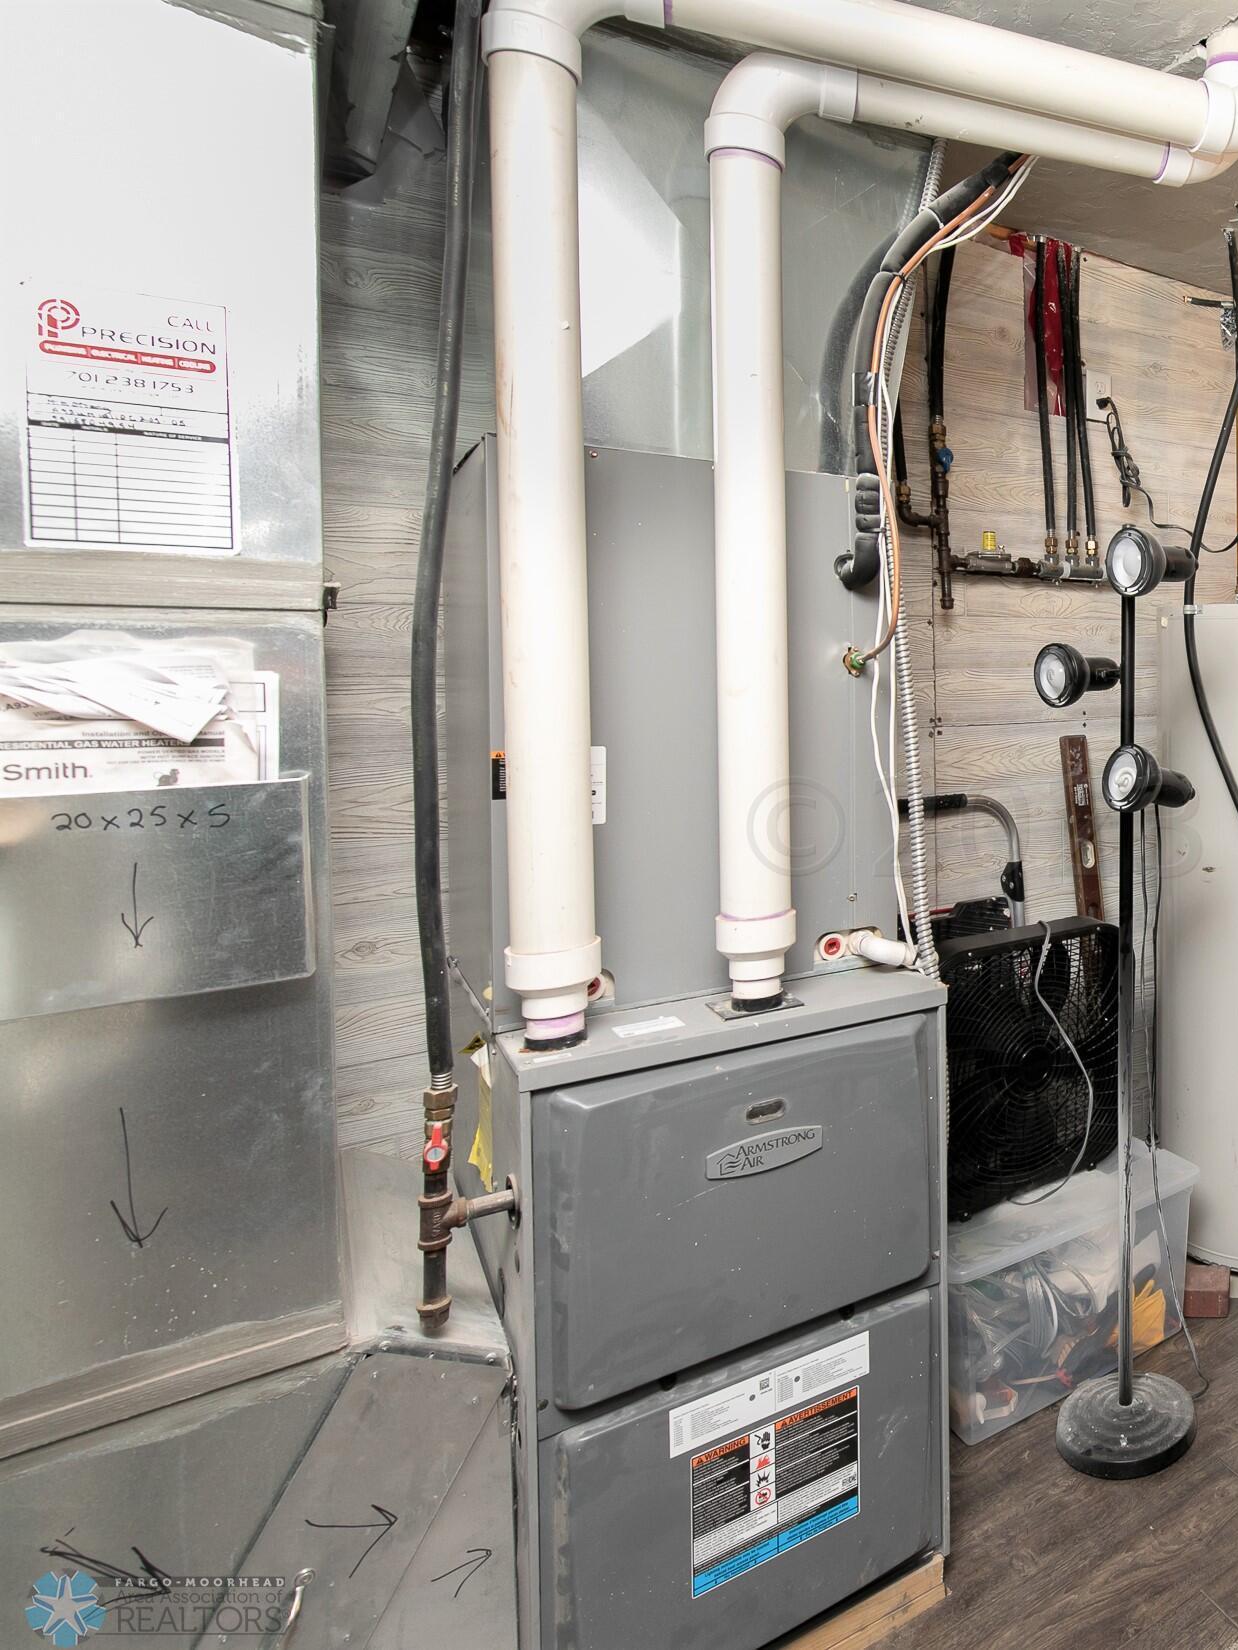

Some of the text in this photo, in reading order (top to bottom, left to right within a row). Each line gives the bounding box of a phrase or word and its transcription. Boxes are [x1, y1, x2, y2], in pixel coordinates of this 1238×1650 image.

[167, 315, 216, 332] CALL
[81, 326, 216, 355] PRECISION
[74, 740, 99, 749] GAS
[101, 740, 140, 749] WATER
[3, 761, 88, 781] Smith
[736, 1129, 816, 1159] ARMSTRONG
[741, 1155, 764, 1170] AIR
[788, 1391, 853, 1425] AVERTISSEMENT
[704, 1436, 746, 1461] WARNING
